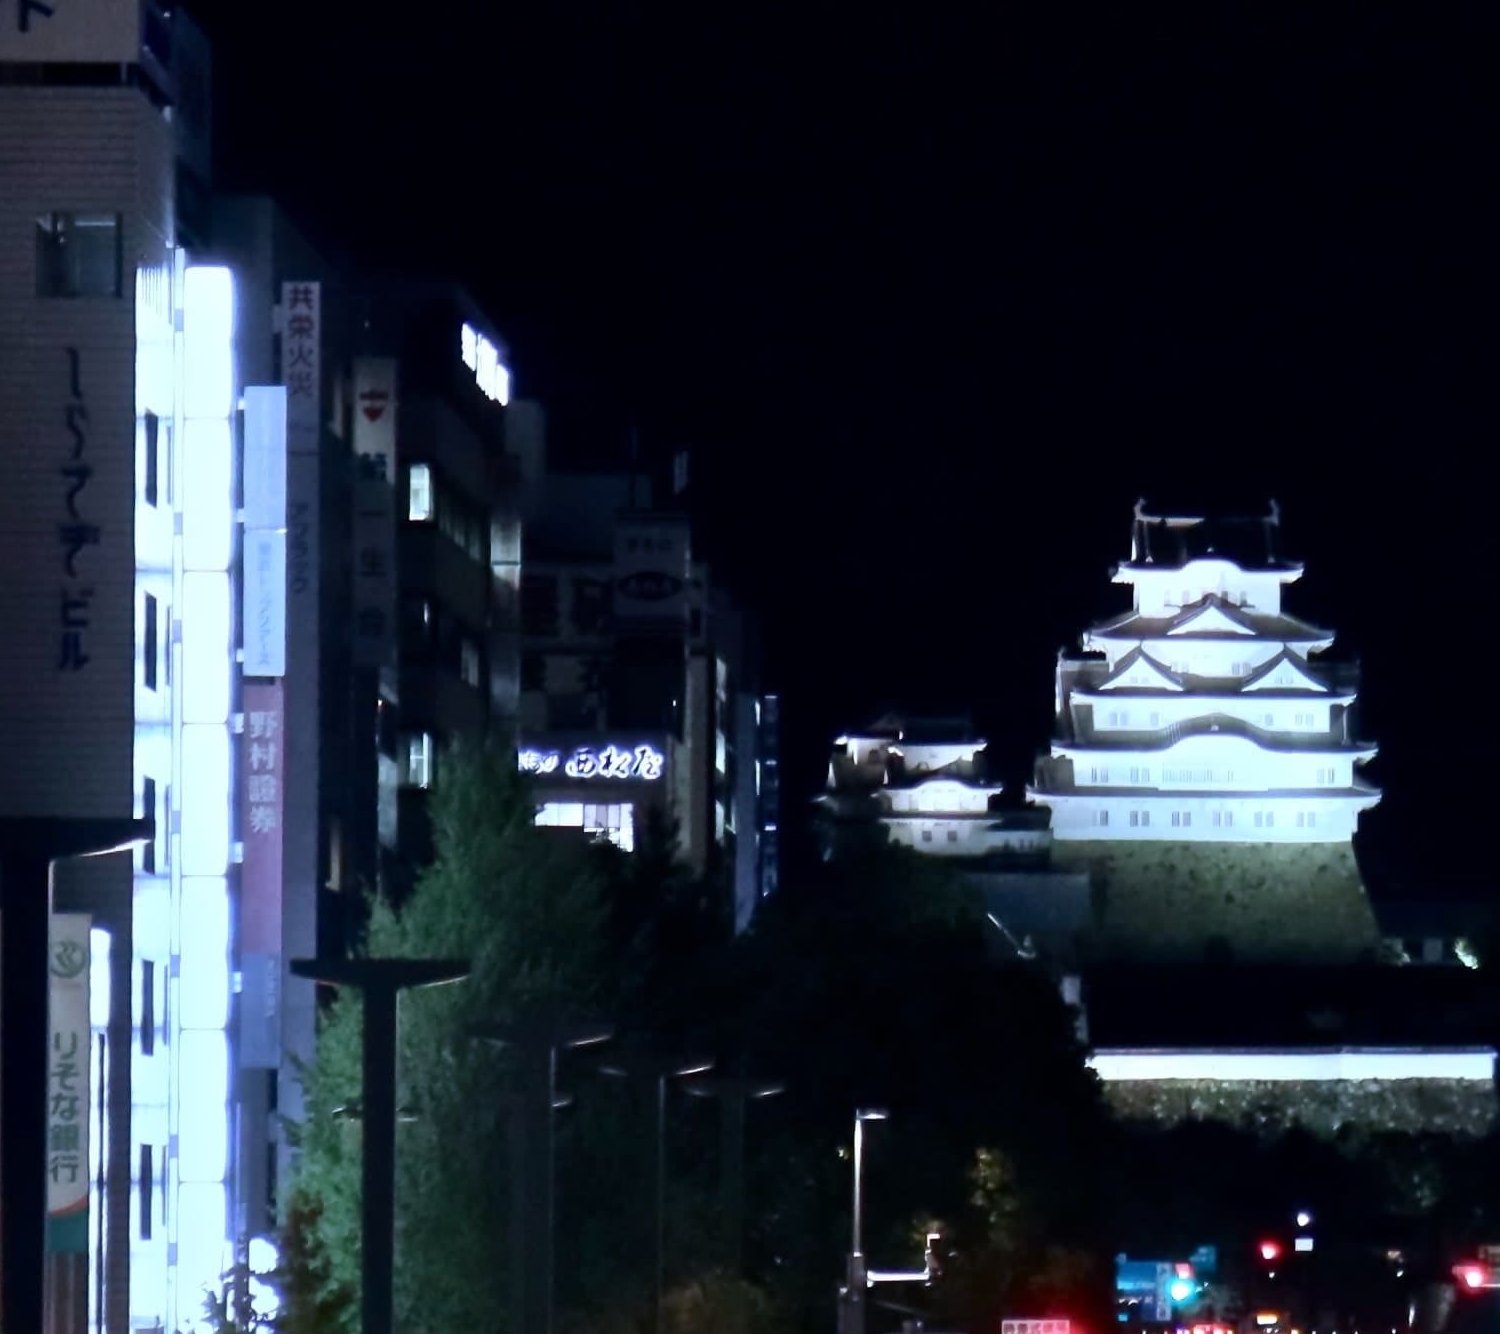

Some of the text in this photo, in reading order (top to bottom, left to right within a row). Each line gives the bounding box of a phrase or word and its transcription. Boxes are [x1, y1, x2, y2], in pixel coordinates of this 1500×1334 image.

[51, 1031, 81, 1184] りそな銀行
